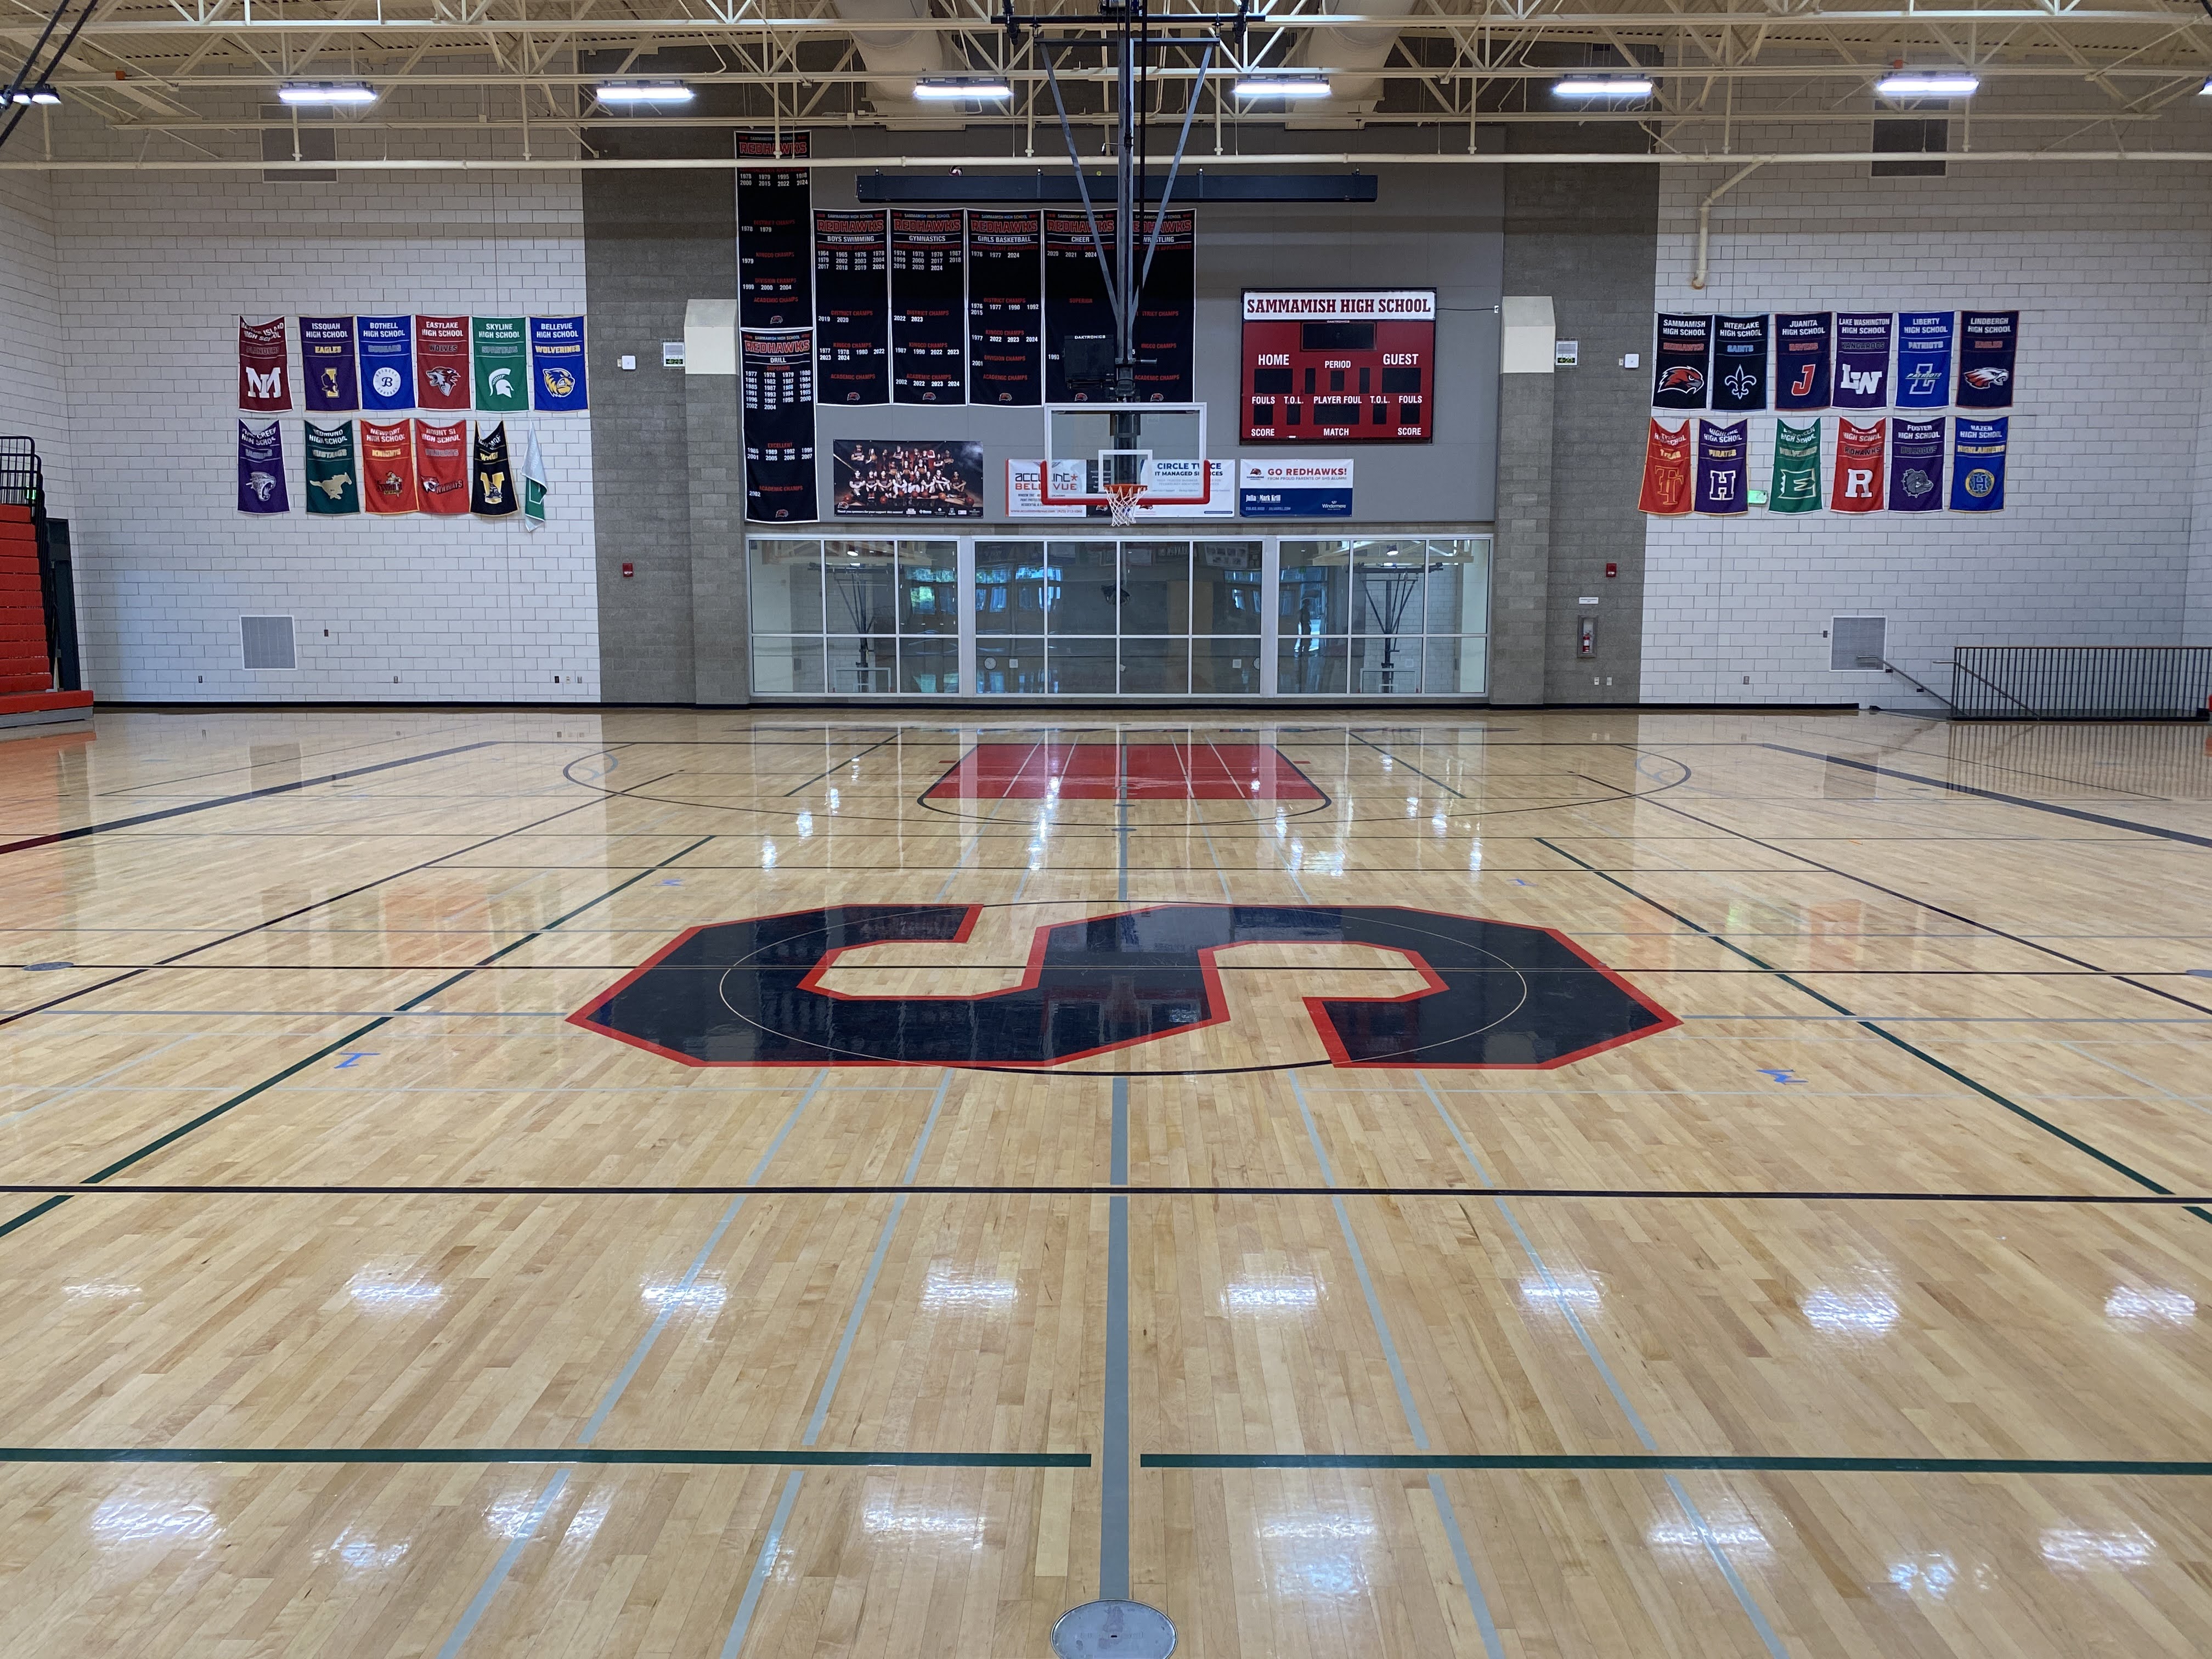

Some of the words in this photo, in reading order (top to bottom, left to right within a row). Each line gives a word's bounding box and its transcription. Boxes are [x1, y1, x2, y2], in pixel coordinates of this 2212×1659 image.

[817, 219, 884, 232] REDHAWKS
[894, 219, 961, 232] REDHAWKS
[971, 219, 1038, 233] REDHAWKS
[1247, 298, 1336, 313] SAMMAMISH
[1340, 298, 1374, 313] HIGH
[1378, 298, 1431, 313] SCHOOL
[1663, 319, 1706, 328] SAMMAMISH
[1790, 319, 1818, 328] JUANITA
[380, 329, 405, 337] SCHOOL
[1737, 329, 1762, 337] SCHOOL
[1799, 327, 1825, 335] SCHOOL
[1984, 325, 2011, 334] SCHOOL
[744, 340, 810, 353] REDHAWKS
[1258, 354, 1289, 366] HOME
[1383, 353, 1419, 365] GUEST
[1324, 360, 1351, 369] PERIOD
[1252, 396, 1276, 404] FOULS
[1284, 396, 1304, 404] T.O.L.
[1313, 396, 1341, 404] PLAYER
[1343, 396, 1362, 404] FOUL
[1370, 396, 1390, 404] T.O.L.
[1398, 395, 1422, 404] FOULS
[370, 427, 400, 436] NEWPORT
[426, 427, 448, 436] MOUNT
[1251, 428, 1275, 437] SCORE
[1323, 428, 1349, 436] MATCH
[1398, 427, 1421, 436] SCORE
[1915, 431, 1940, 439] SCHOOL
[309, 435, 324, 443] HIGH
[325, 435, 348, 444] SCHOOL
[381, 433, 405, 442] SCHOOL
[421, 433, 437, 442] HIGH
[437, 433, 461, 443] SCHOOL
[1843, 432, 1858, 441] HIGH
[1845, 469, 1874, 498] R
